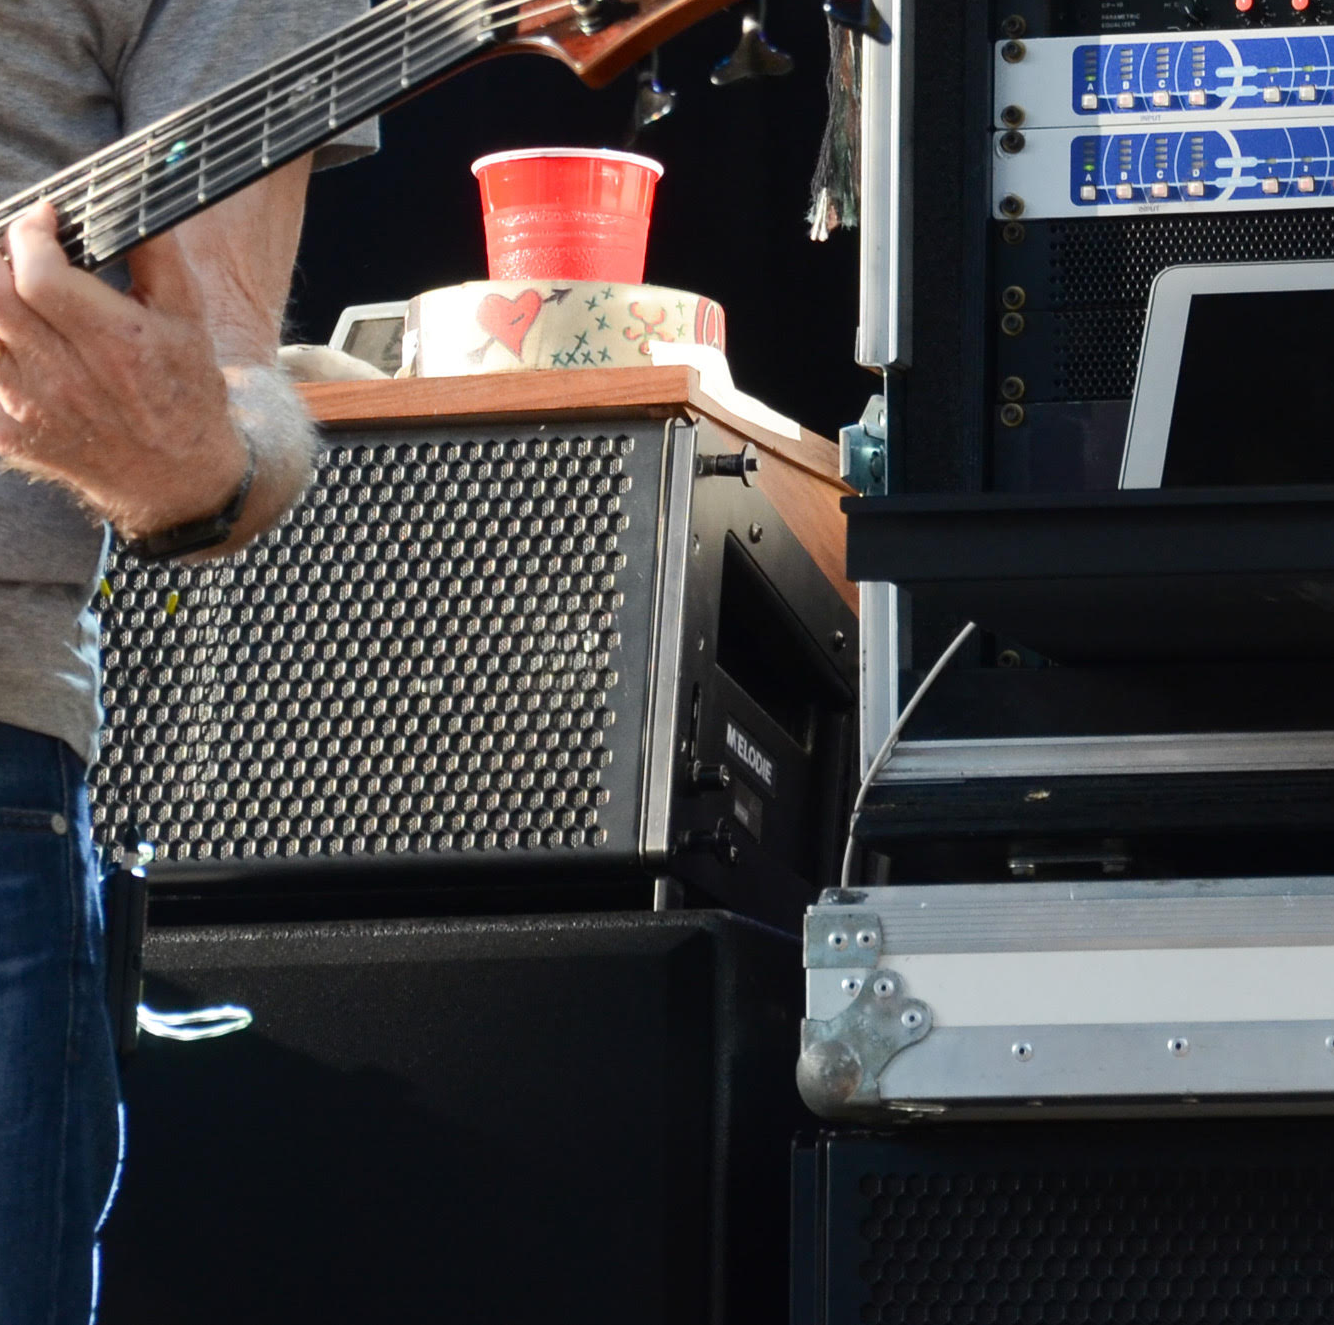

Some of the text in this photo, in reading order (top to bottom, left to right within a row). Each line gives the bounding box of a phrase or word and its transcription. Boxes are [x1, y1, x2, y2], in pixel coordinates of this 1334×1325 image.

[1086, 78, 1202, 91] A B C D
[1085, 173, 1092, 181] A
[1156, 170, 1164, 179] C
